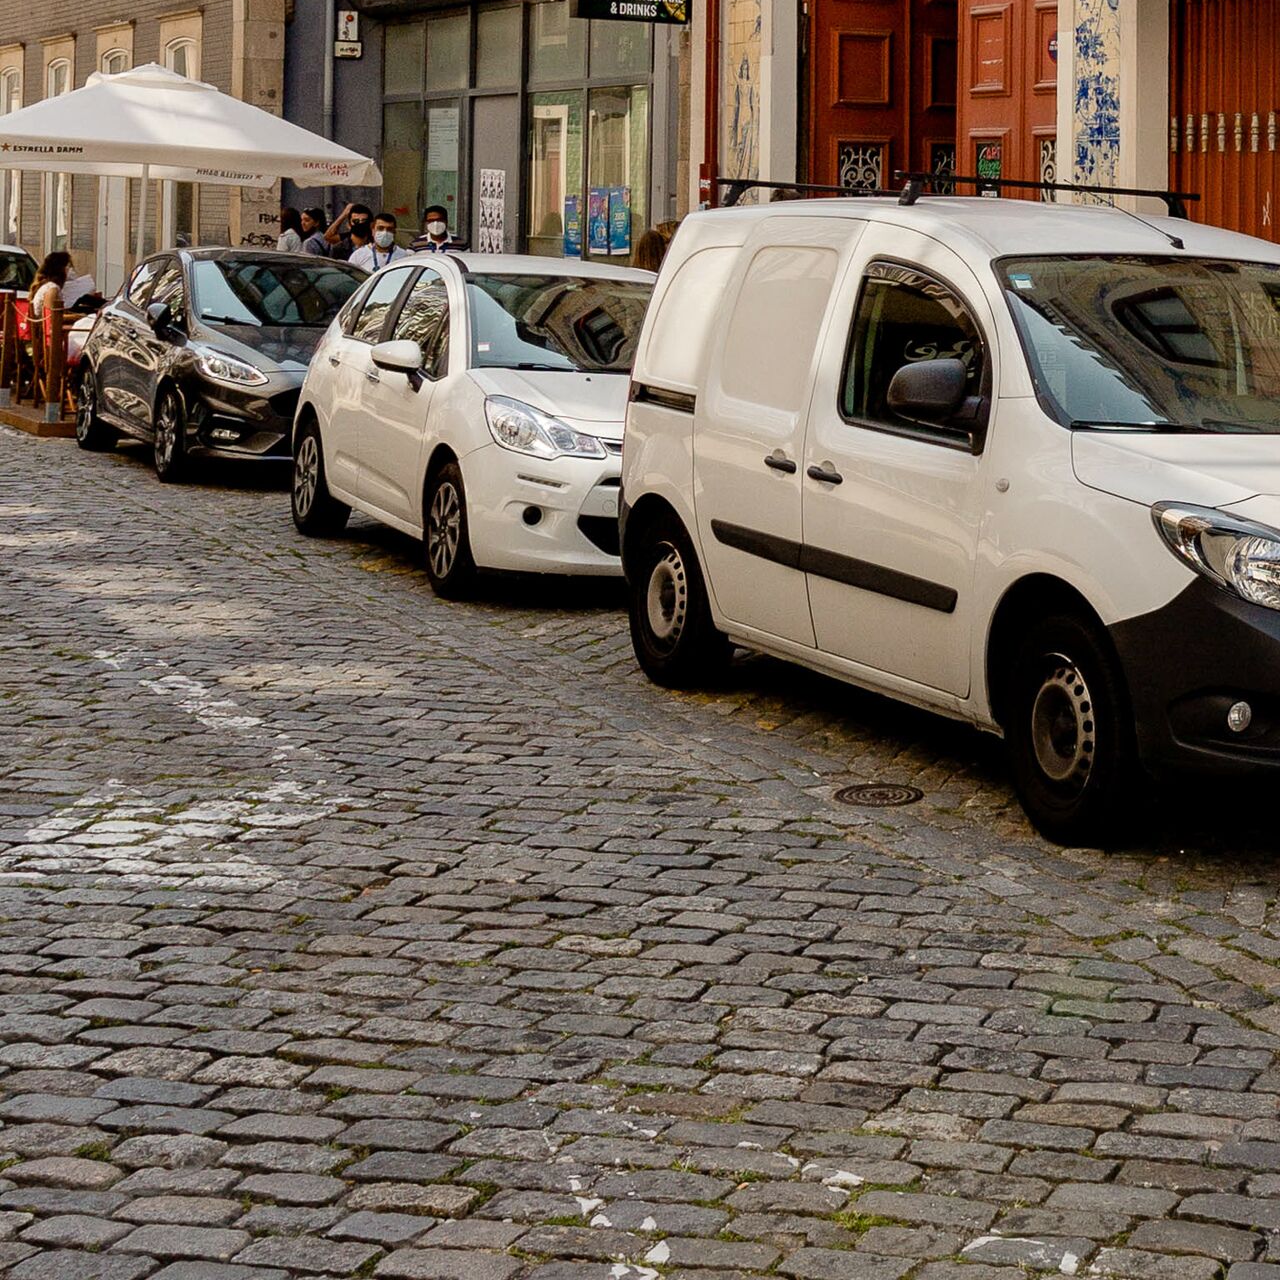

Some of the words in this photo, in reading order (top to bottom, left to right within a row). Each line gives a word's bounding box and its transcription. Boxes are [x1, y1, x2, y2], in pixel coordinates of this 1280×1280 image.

[610, 2, 618, 15] &
[619, 3, 658, 17] DRINKS
[13, 145, 54, 153] ESTRELLA
